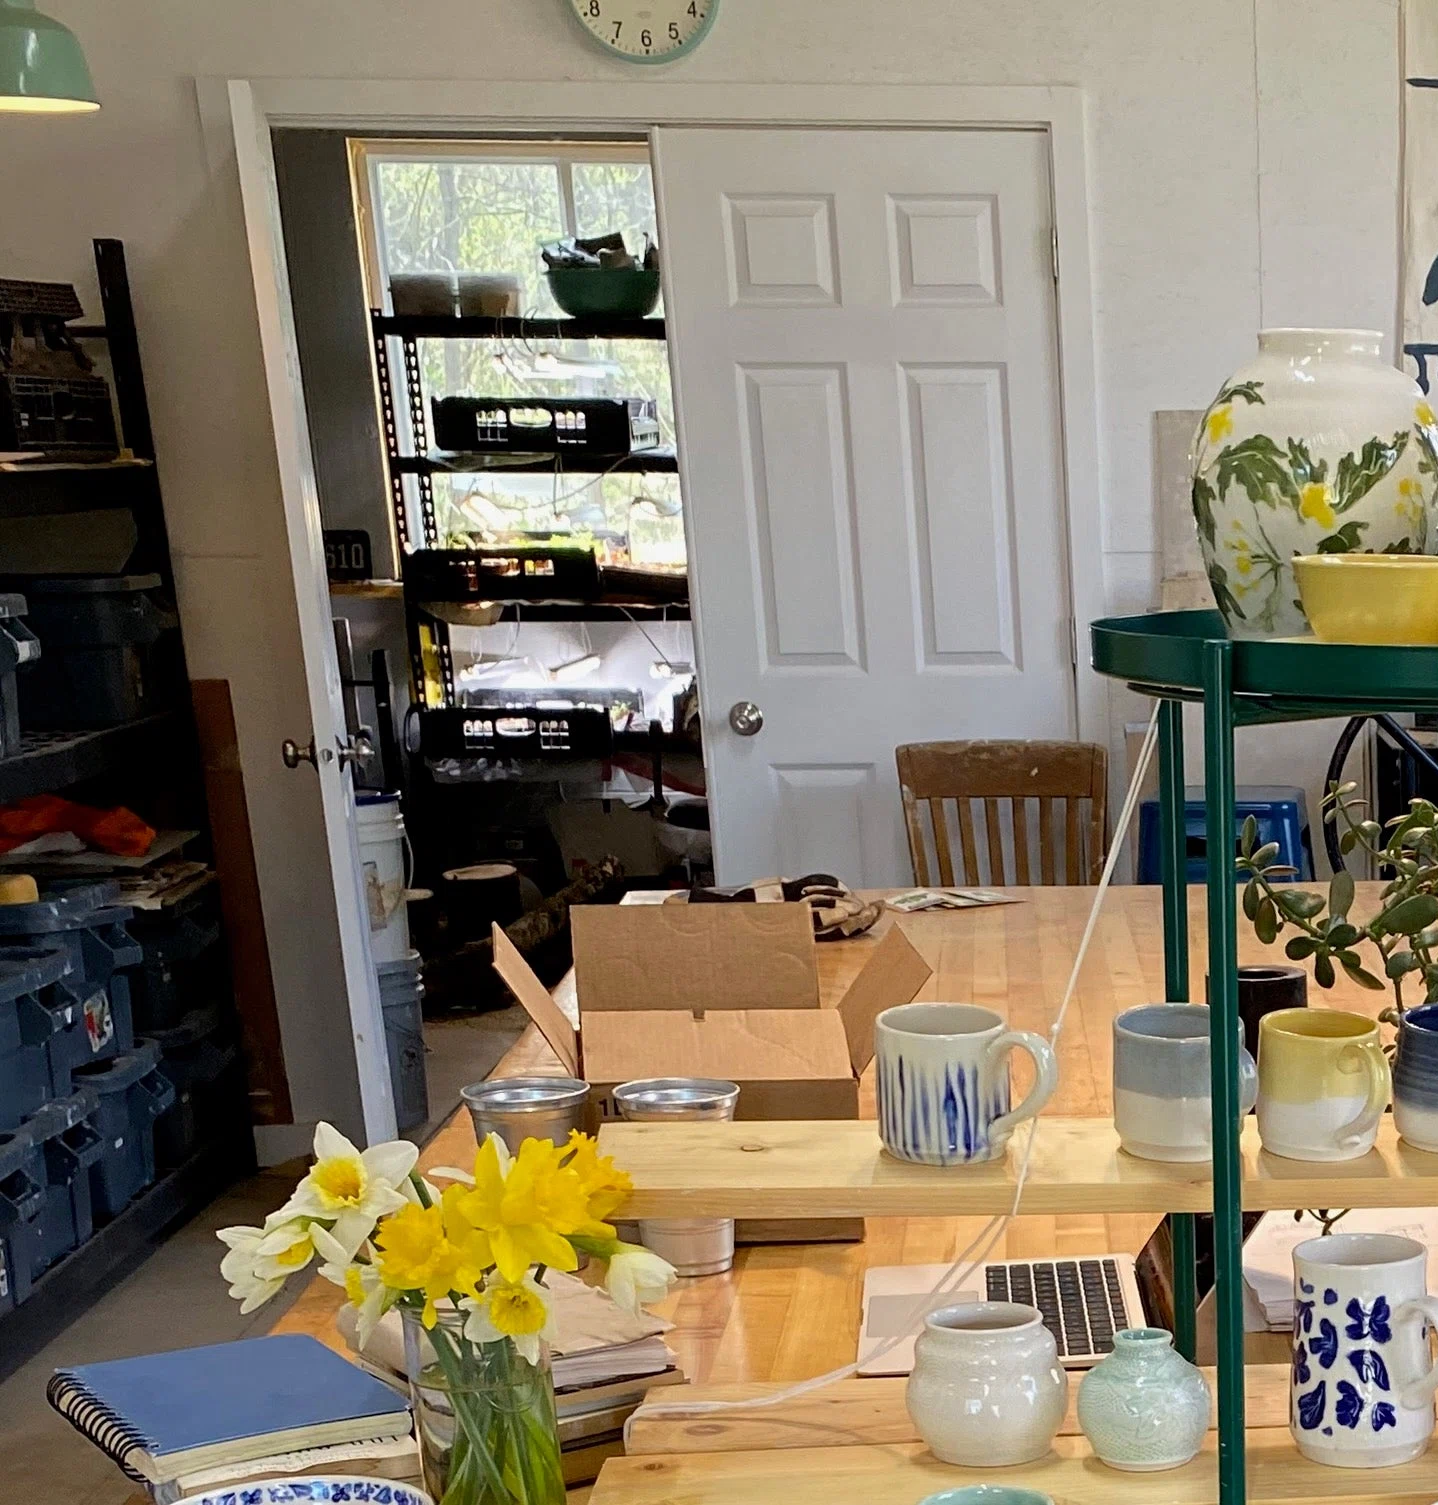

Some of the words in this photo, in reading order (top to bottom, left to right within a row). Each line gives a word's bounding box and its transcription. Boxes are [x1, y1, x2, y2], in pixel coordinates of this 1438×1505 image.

[589, 0, 600, 17] 8
[687, 1, 697, 18] 4
[612, 21, 623, 39] 7
[641, 30, 652, 47] 6
[668, 23, 679, 40] 5
